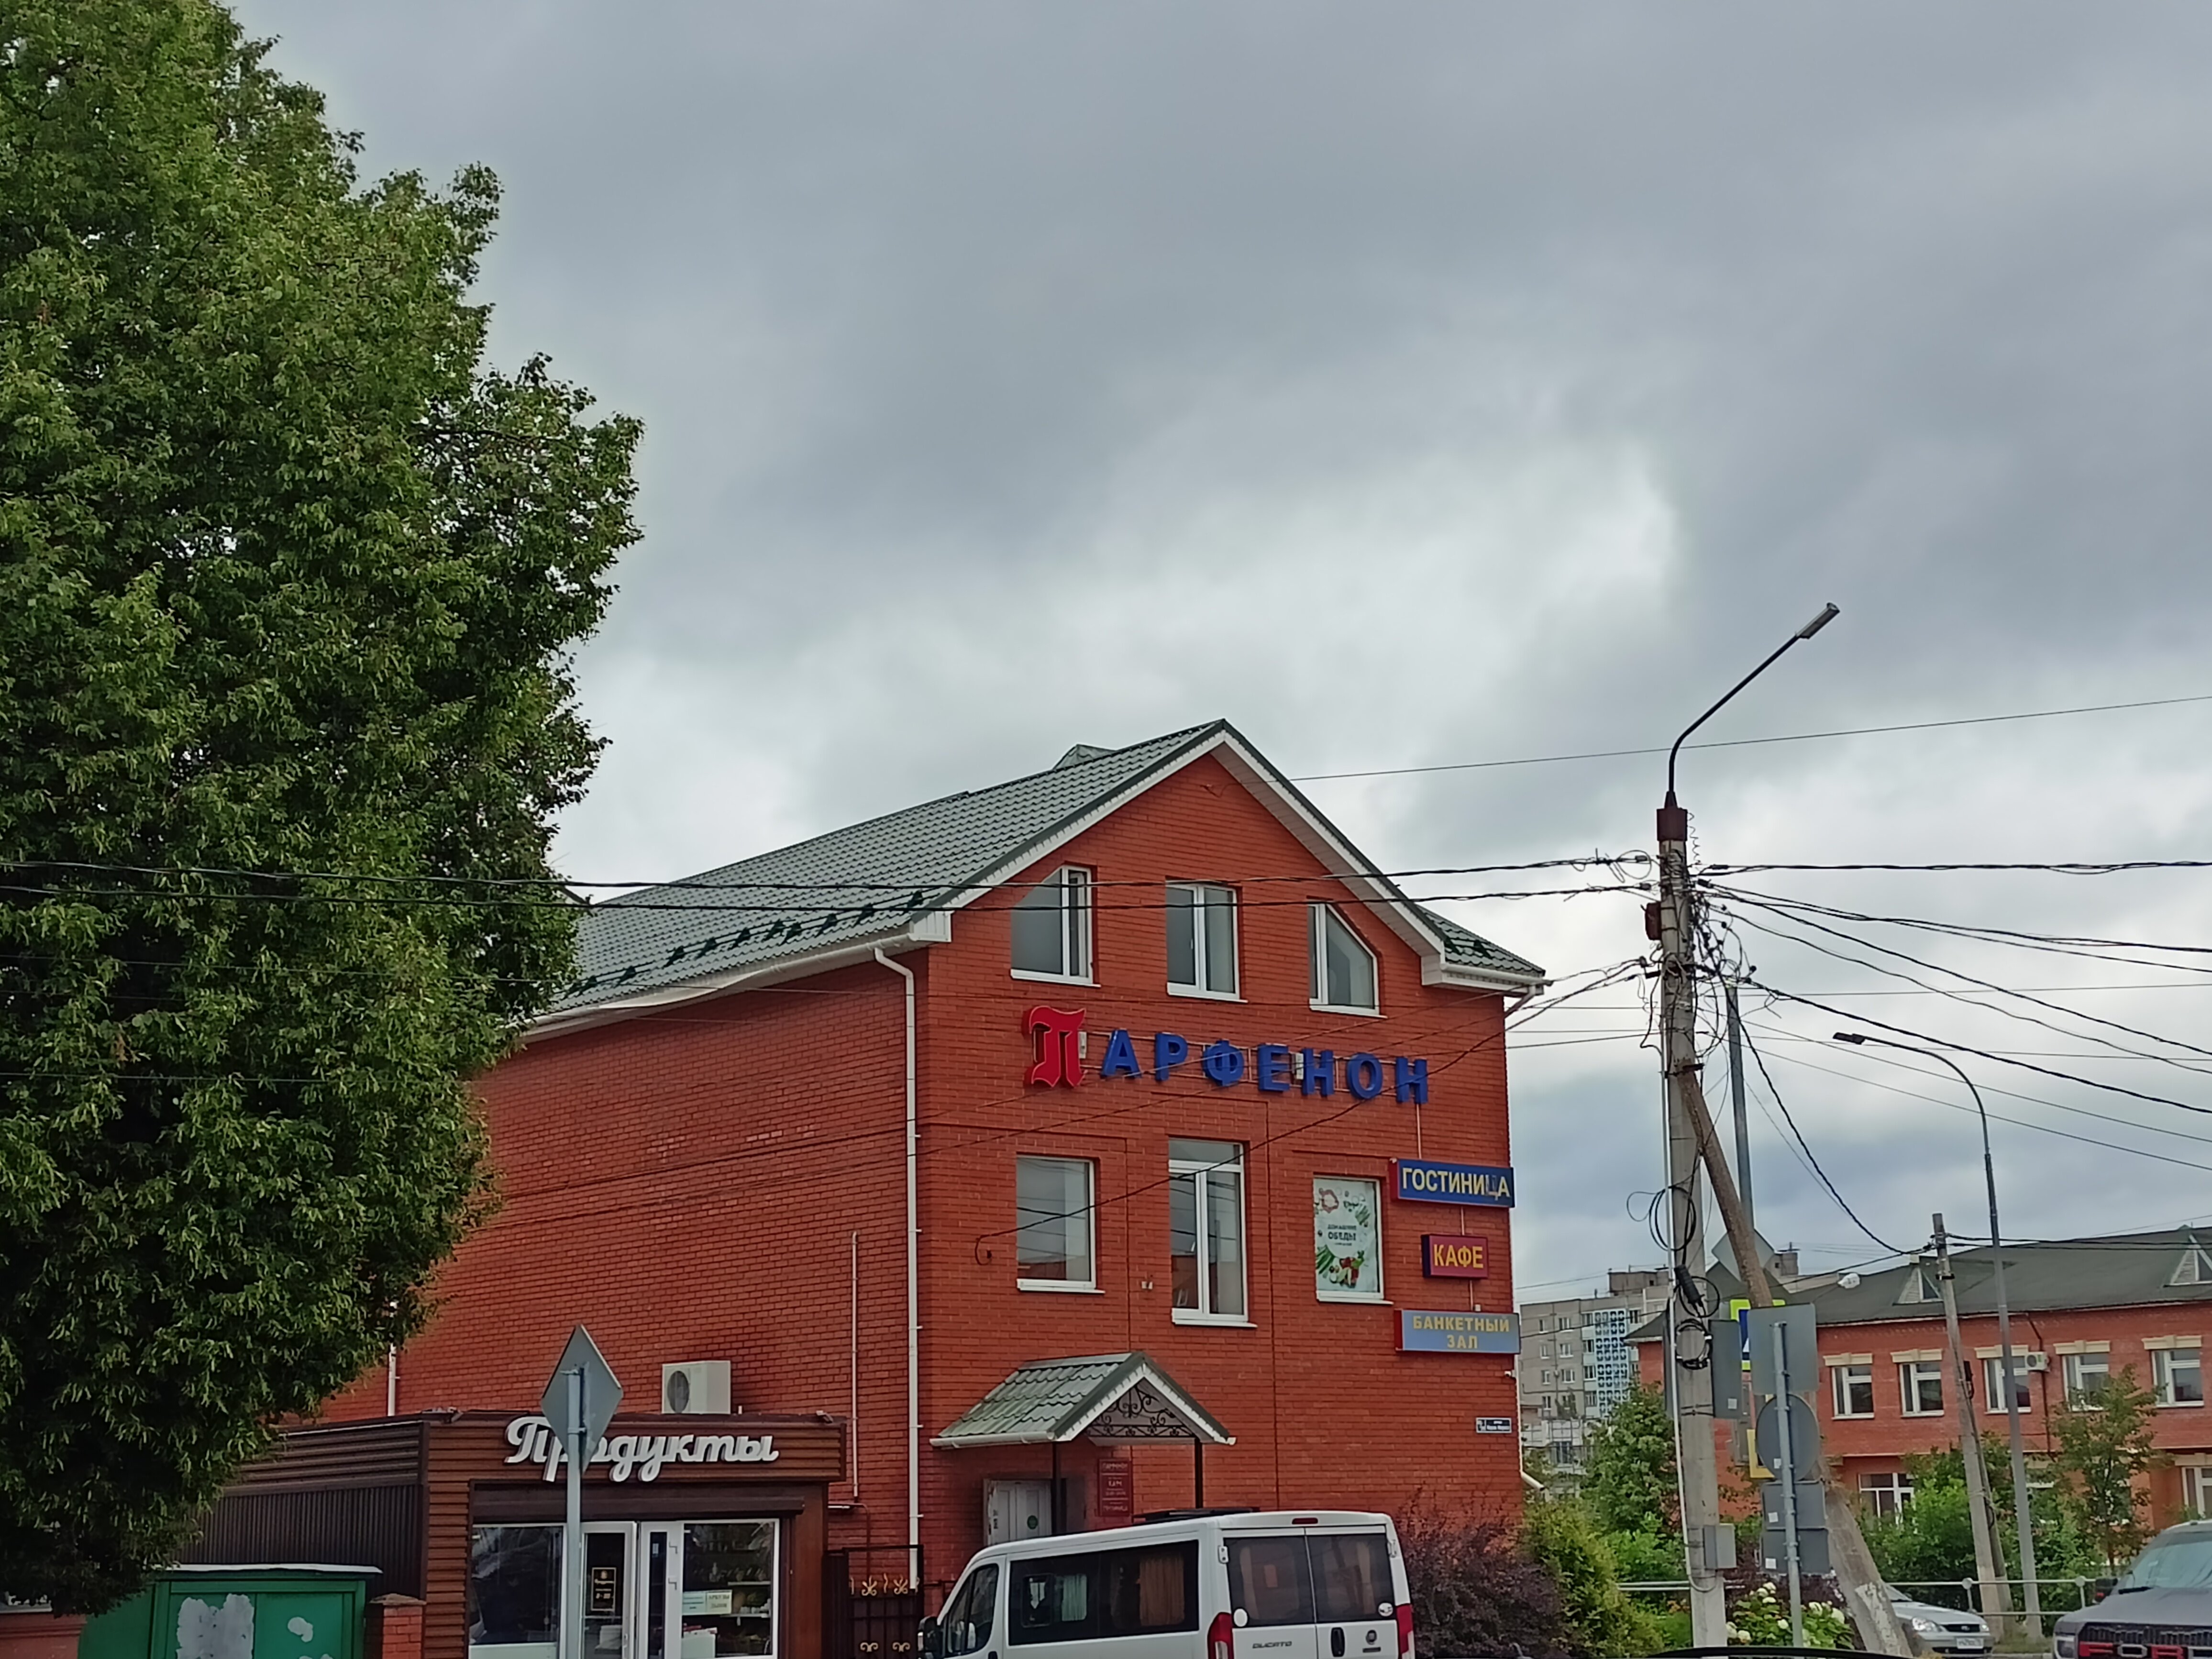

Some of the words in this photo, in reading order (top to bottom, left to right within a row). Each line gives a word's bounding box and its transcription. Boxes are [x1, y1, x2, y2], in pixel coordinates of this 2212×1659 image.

[1022, 1006, 1428, 1104] ПАРФЕНОН
[1402, 1167, 1510, 1201] ГОСТИНИЦА
[1328, 1231, 1356, 1241] ОБЕДЫ
[1434, 1244, 1483, 1268] КАФЕ
[1413, 1316, 1510, 1332] БАНКЕТНЫЙ
[1447, 1335, 1478, 1349] ЗАЛ
